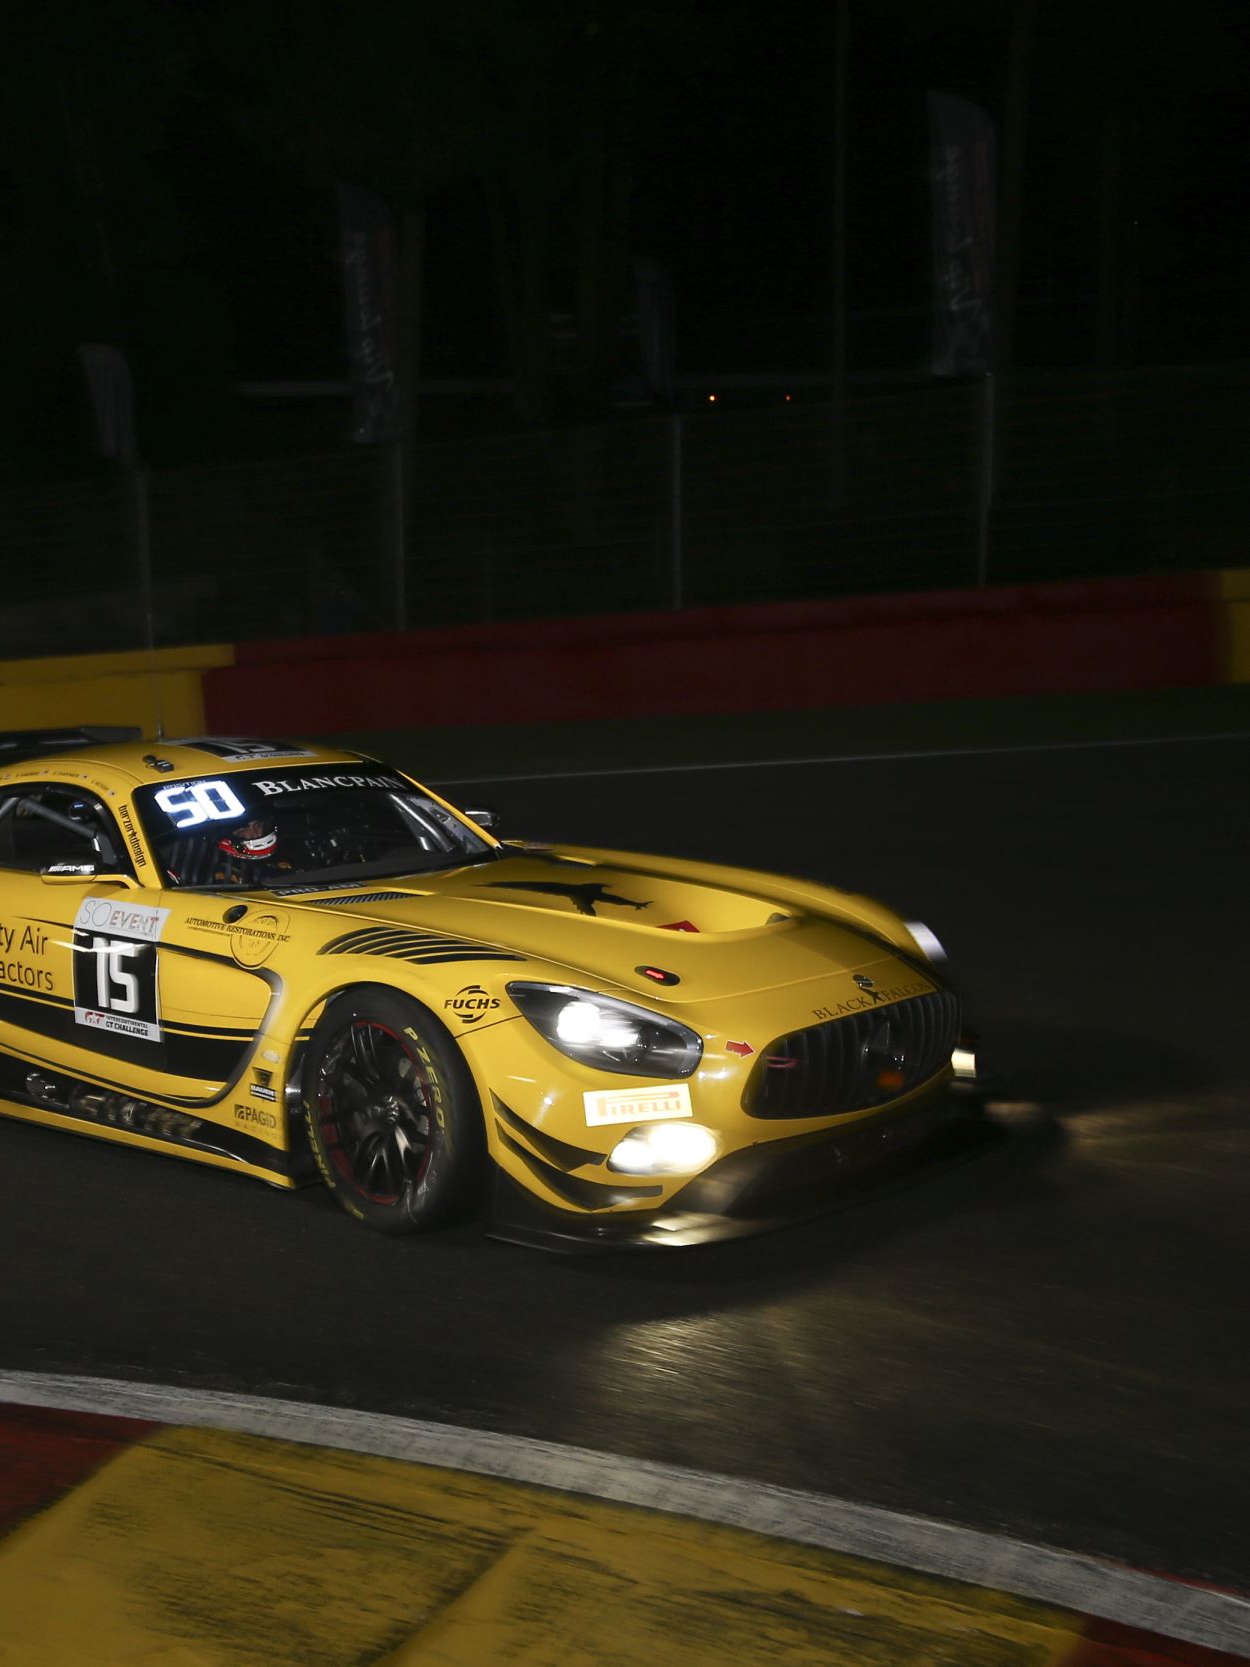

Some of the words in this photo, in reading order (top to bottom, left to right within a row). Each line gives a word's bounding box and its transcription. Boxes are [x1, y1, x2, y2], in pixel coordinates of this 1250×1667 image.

[251, 775, 408, 796] BLANCPAIN
[154, 780, 246, 828] 50
[60, 864, 95, 873] AMG
[19, 925, 49, 955] Air
[184, 917, 227, 931] AUTOMOTIVE
[226, 924, 277, 941] RESTORATIONS
[92, 936, 139, 1014] 15
[444, 997, 501, 1010] FUCHS
[812, 997, 872, 1020] BLACK
[114, 1022, 149, 1037] CHALLENGE
[597, 1090, 682, 1118] PIRELLI
[245, 1106, 277, 1129] PAGID
